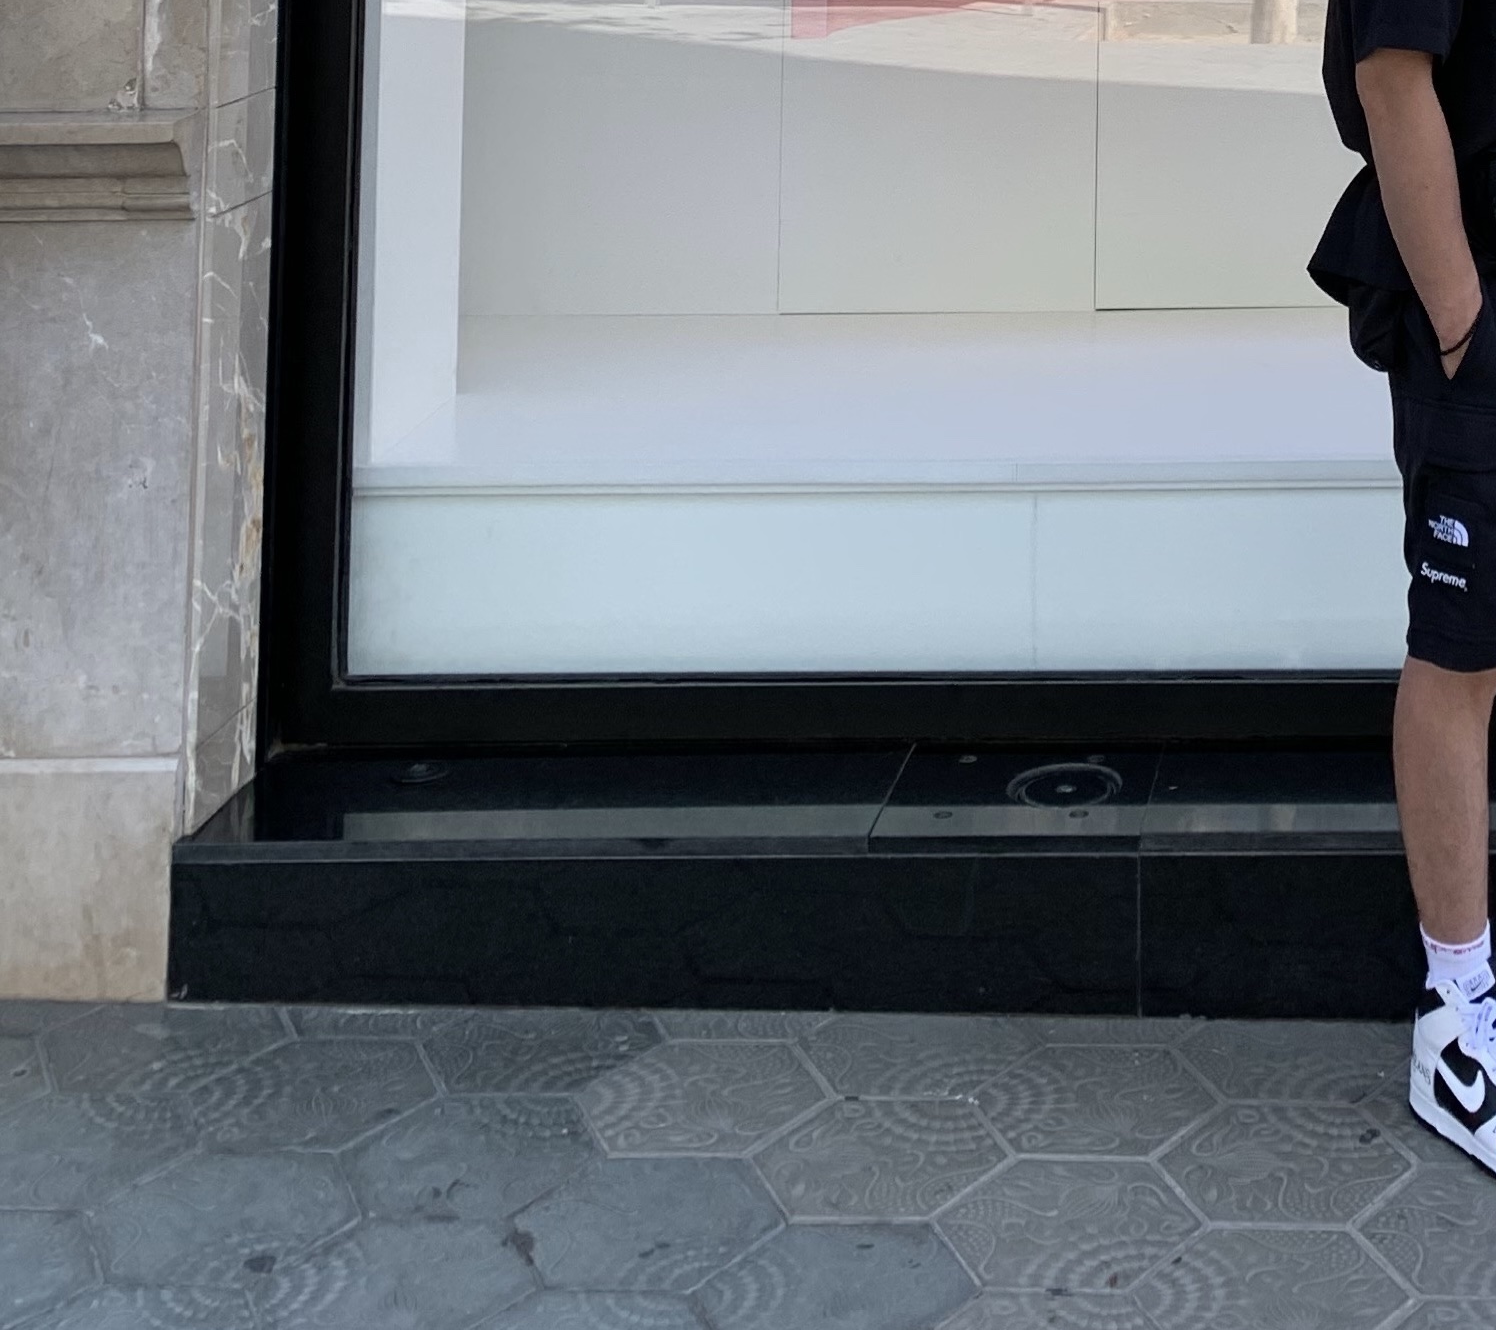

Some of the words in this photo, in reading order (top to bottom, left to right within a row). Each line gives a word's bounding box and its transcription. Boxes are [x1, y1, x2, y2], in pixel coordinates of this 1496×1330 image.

[1428, 519, 1454, 535] NORTH
[1439, 514, 1455, 527] THE
[1433, 528, 1454, 544] FACE
[1420, 561, 1467, 589] Supreme
